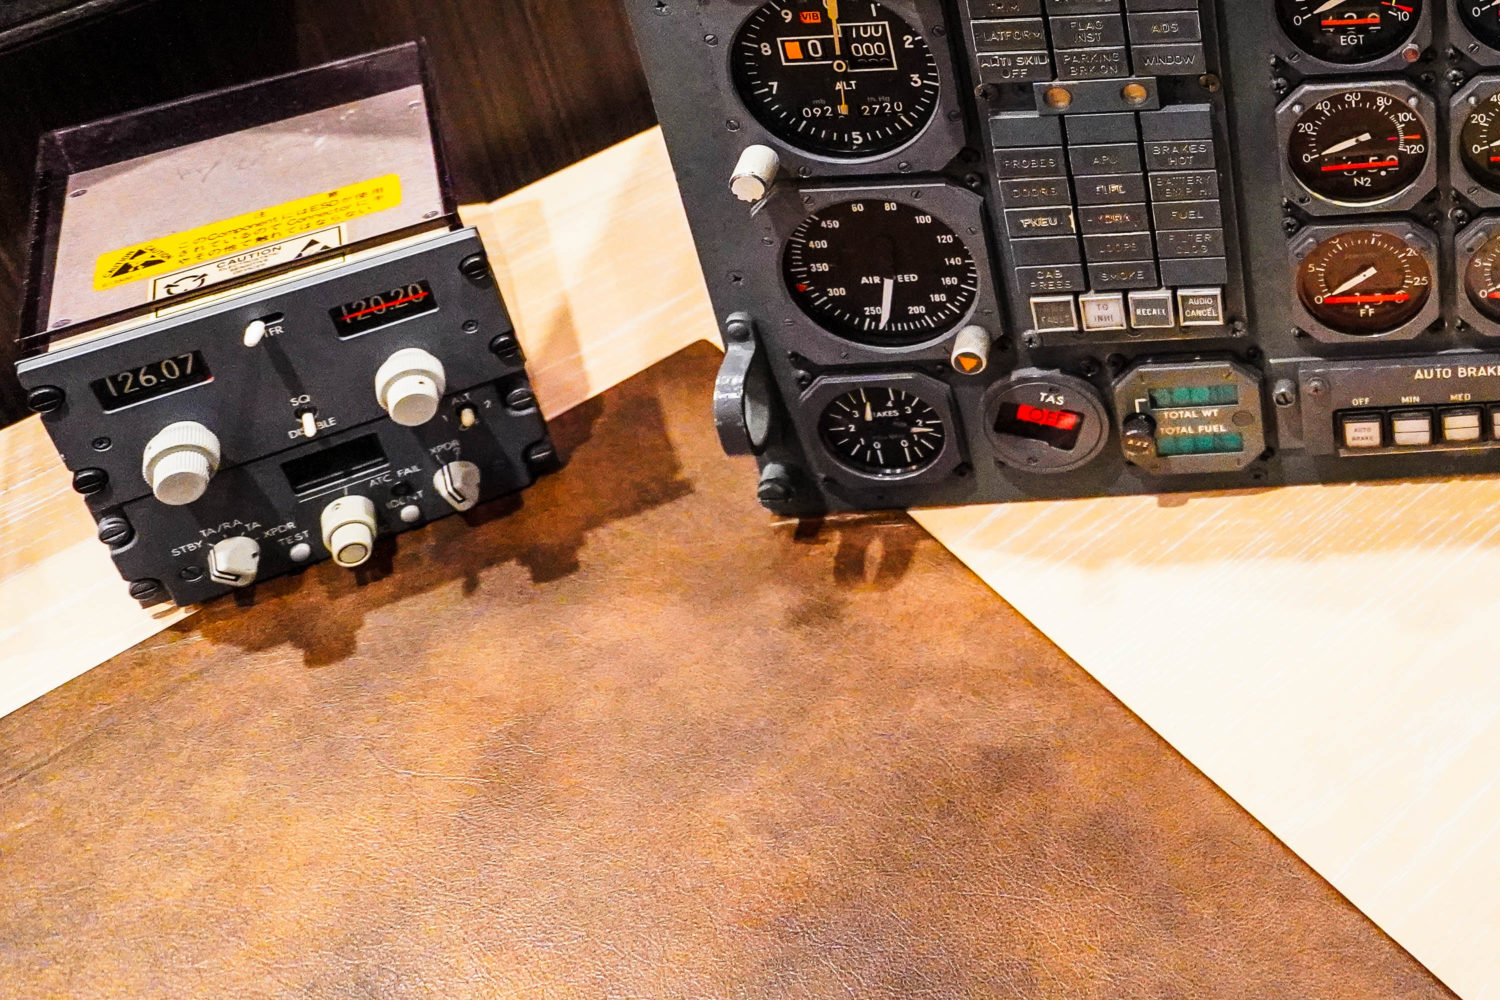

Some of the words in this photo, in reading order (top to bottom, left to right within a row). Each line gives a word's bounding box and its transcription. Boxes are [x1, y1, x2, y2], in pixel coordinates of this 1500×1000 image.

[801, 12, 820, 22] VIB
[1340, 34, 1364, 46] EGT
[1142, 55, 1196, 67] WINDOW
[1001, 68, 1028, 80] OFF
[835, 81, 857, 91] ALT
[1152, 144, 1208, 156] BRAKES
[1353, 176, 1372, 188] N2
[808, 240, 828, 250] 400
[215, 244, 283, 269] CAUTION
[944, 256, 962, 266] 140
[810, 262, 829, 272] 350
[941, 276, 958, 286] 160
[827, 287, 846, 297] 300
[929, 293, 946, 302] 180
[1188, 297, 1214, 306] AUDIO
[864, 306, 882, 316] 250
[907, 305, 926, 315] 200
[1185, 307, 1219, 318] CANCEL
[104, 352, 195, 397] 126.07
[1414, 367, 1452, 380] AUTO
[1039, 391, 1065, 405] TAS
[1352, 397, 1370, 407] OFF
[1401, 395, 1420, 405] MIN
[1450, 392, 1471, 402] MED
[1163, 410, 1198, 420] TOTAL
[1201, 408, 1219, 418] WT
[1160, 426, 1195, 436] TOTAL
[1198, 424, 1227, 434] FUEL
[277, 530, 309, 546] TEST
[170, 540, 203, 557] STBY
